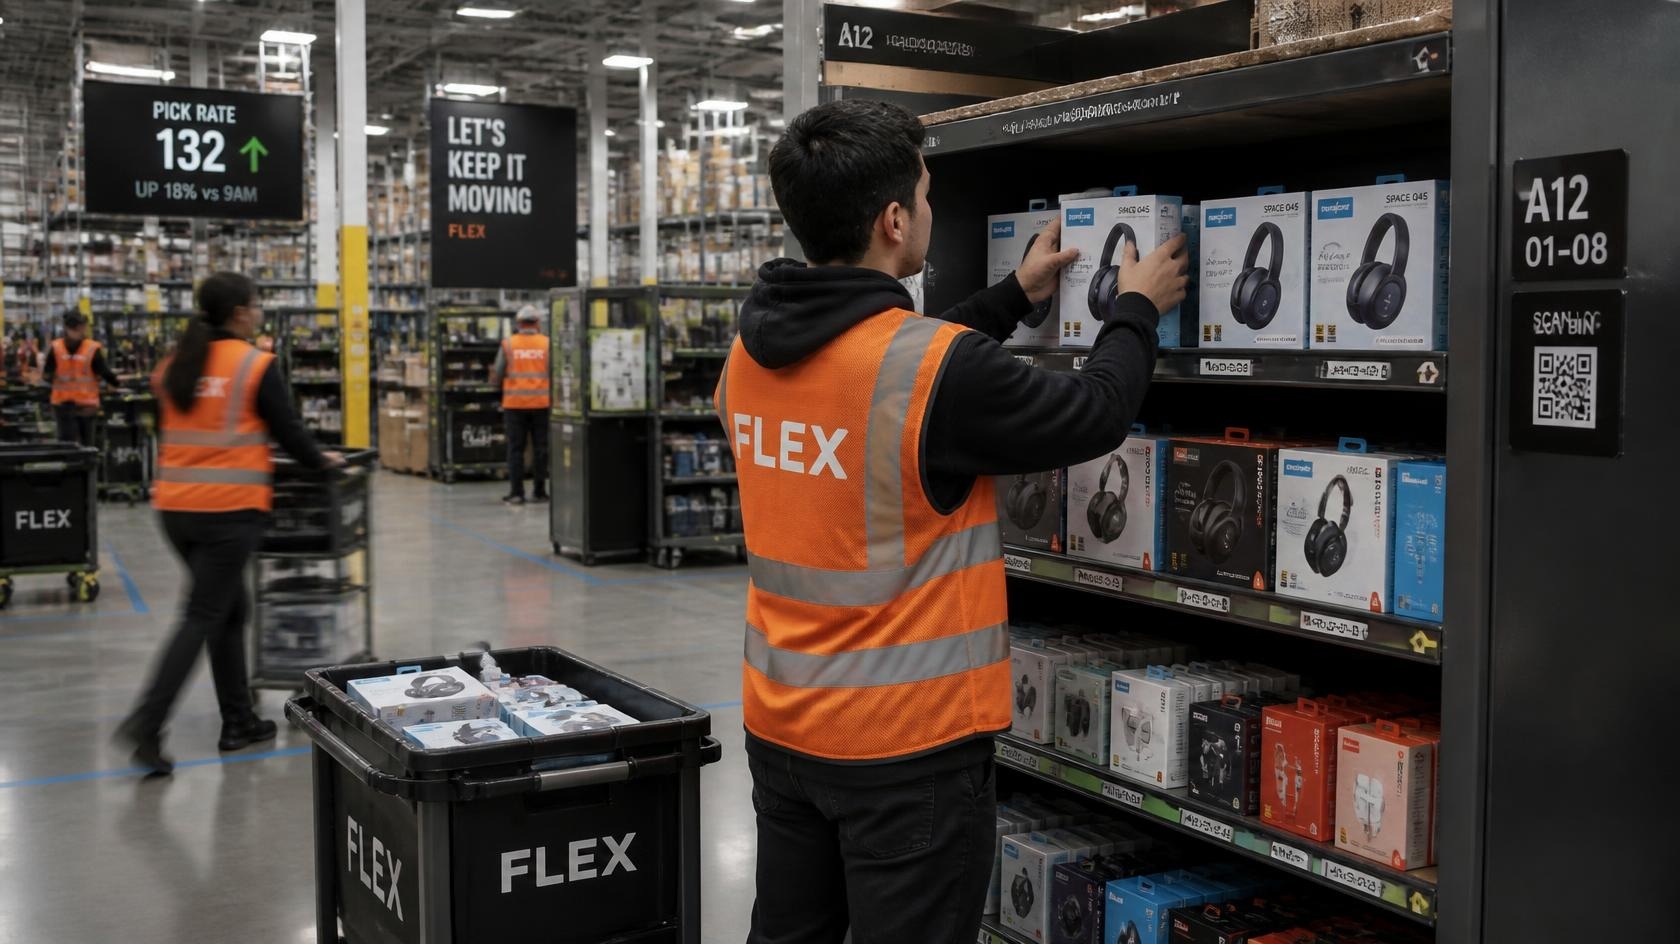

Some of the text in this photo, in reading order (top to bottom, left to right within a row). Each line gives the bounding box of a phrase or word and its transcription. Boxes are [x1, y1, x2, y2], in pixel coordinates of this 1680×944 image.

[838, 22, 873, 49] A12
[153, 101, 237, 125] PICK RATE
[448, 116, 506, 148] LET'S
[155, 128, 227, 173] 132
[448, 149, 527, 182] KEEP IT
[135, 181, 258, 203] UP 18% vs 9AM
[448, 183, 532, 215] MOVING
[1386, 193, 1411, 204] SPACE
[1524, 174, 1589, 224] A12
[448, 223, 486, 240] FLEX
[1525, 231, 1608, 268] 01-08
[733, 412, 849, 480] FLEX
[15, 508, 72, 530] FLEX
[347, 815, 405, 922] FLEX
[500, 832, 638, 894] FLEX
